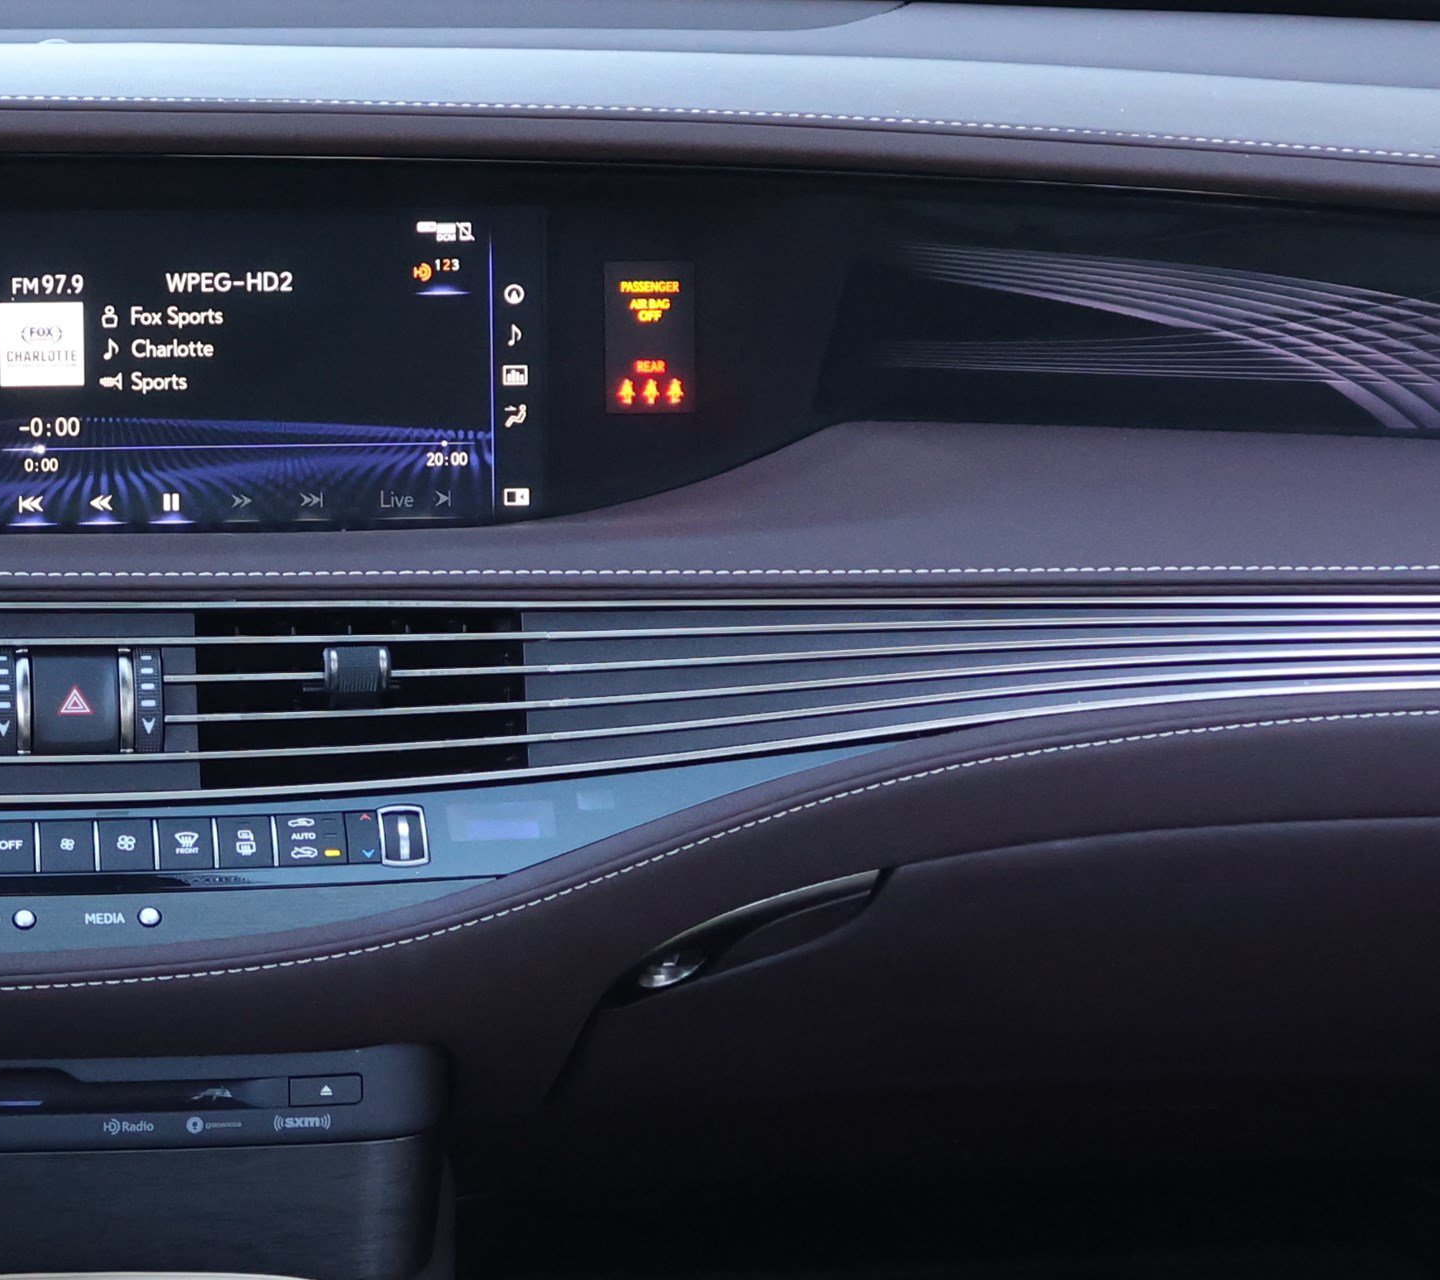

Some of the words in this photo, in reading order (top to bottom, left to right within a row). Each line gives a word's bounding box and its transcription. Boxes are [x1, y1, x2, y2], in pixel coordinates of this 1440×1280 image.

[11, 277, 39, 294] FM
[41, 274, 84, 294] 97.9
[165, 271, 293, 293] WPEG-HD2
[619, 280, 680, 293] PASSENGER
[628, 298, 648, 310] AIR
[130, 306, 162, 325] Fox
[167, 306, 224, 328] Sports
[637, 310, 663, 322] OFF
[29, 327, 53, 337] FOX
[131, 339, 214, 358] Charlotte
[6, 349, 77, 362] CHARLOTTE
[636, 360, 666, 374] REAR
[131, 372, 188, 394] Sports
[24, 458, 59, 472] 0:00
[426, 452, 468, 466] 20:00
[380, 491, 414, 508] Live
[291, 832, 316, 840] AUTO
[175, 847, 200, 855] FRONT
[84, 912, 125, 924] MEDIA
[122, 1120, 154, 1132] Radio
